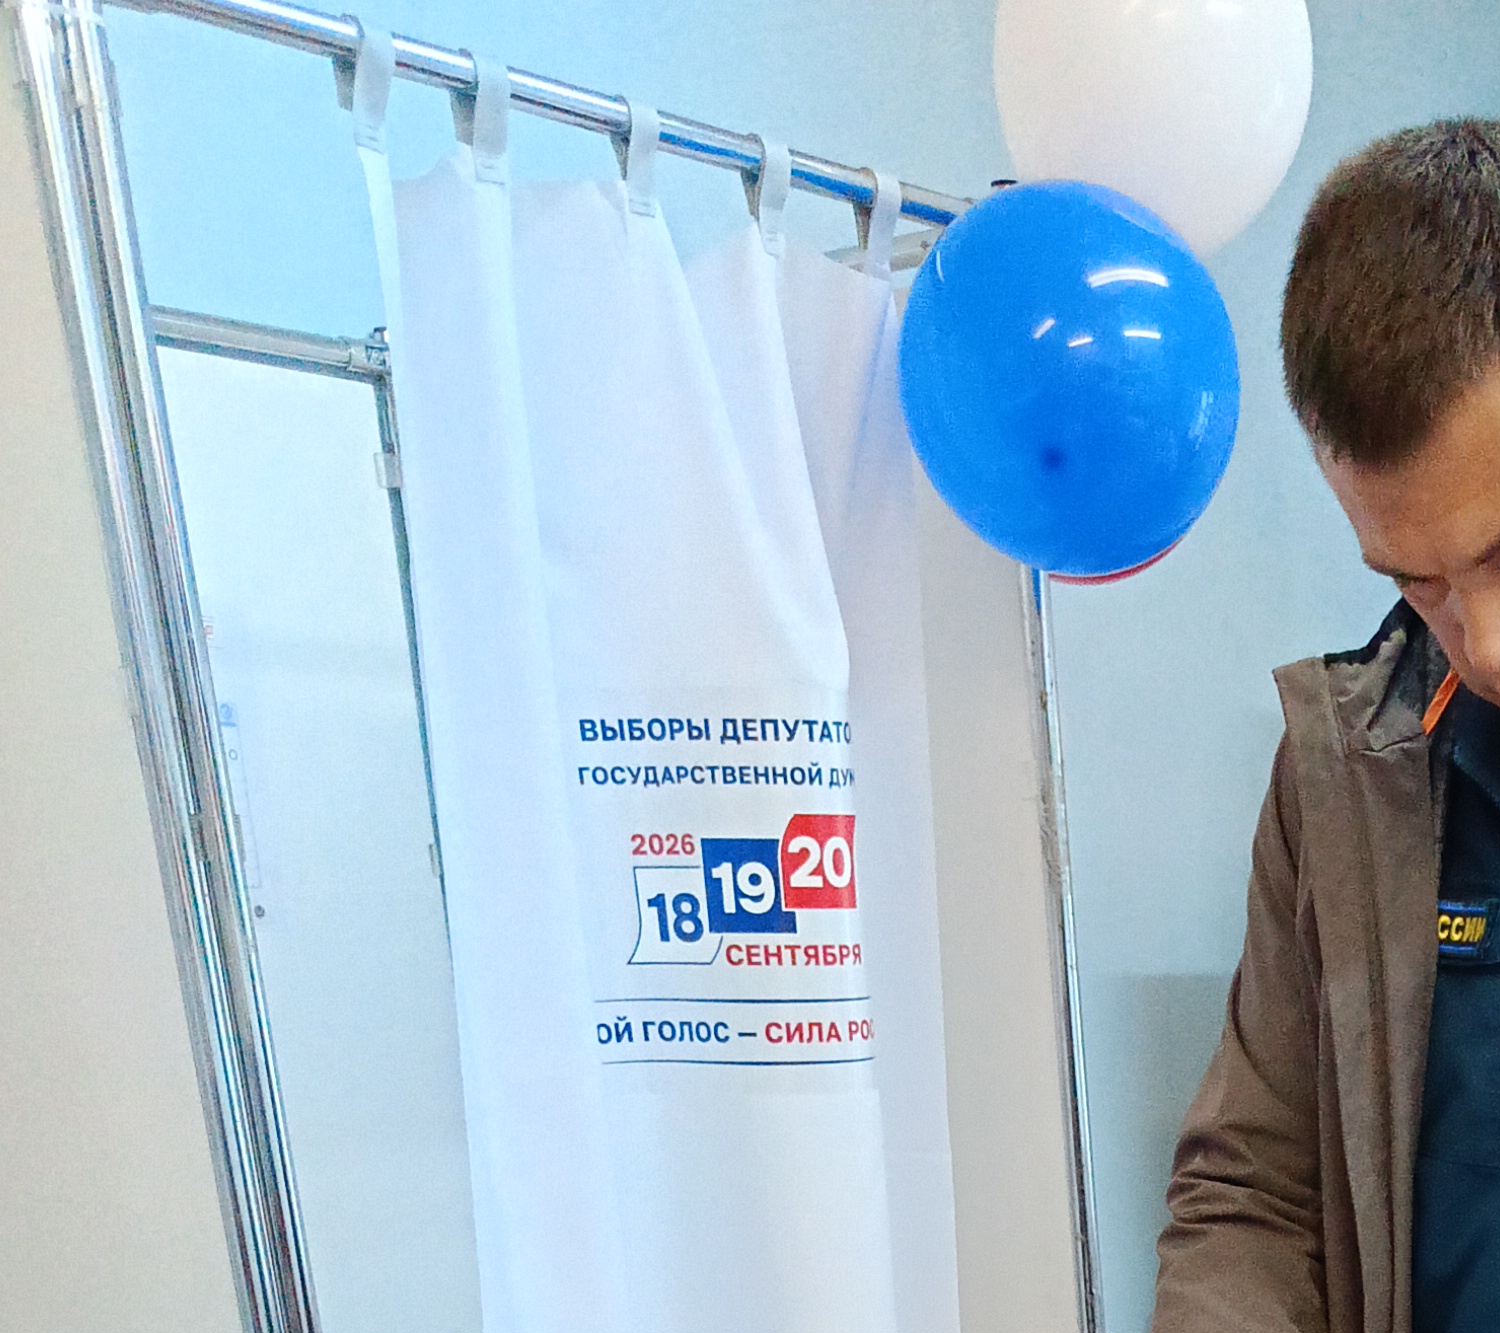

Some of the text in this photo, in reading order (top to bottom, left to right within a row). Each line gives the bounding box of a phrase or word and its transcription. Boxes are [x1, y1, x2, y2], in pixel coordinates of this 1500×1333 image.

[579, 718, 711, 742] ВЫБОРЫ
[578, 761, 823, 788] ГОСУДАРСТВЕННОЙ
[631, 834, 695, 856] 2026
[647, 836, 852, 942] 18 19 20
[726, 943, 862, 967] СЕНТЯБРЯ
[642, 1020, 730, 1043] ГОЛОС
[765, 1021, 842, 1043] СИЛА
